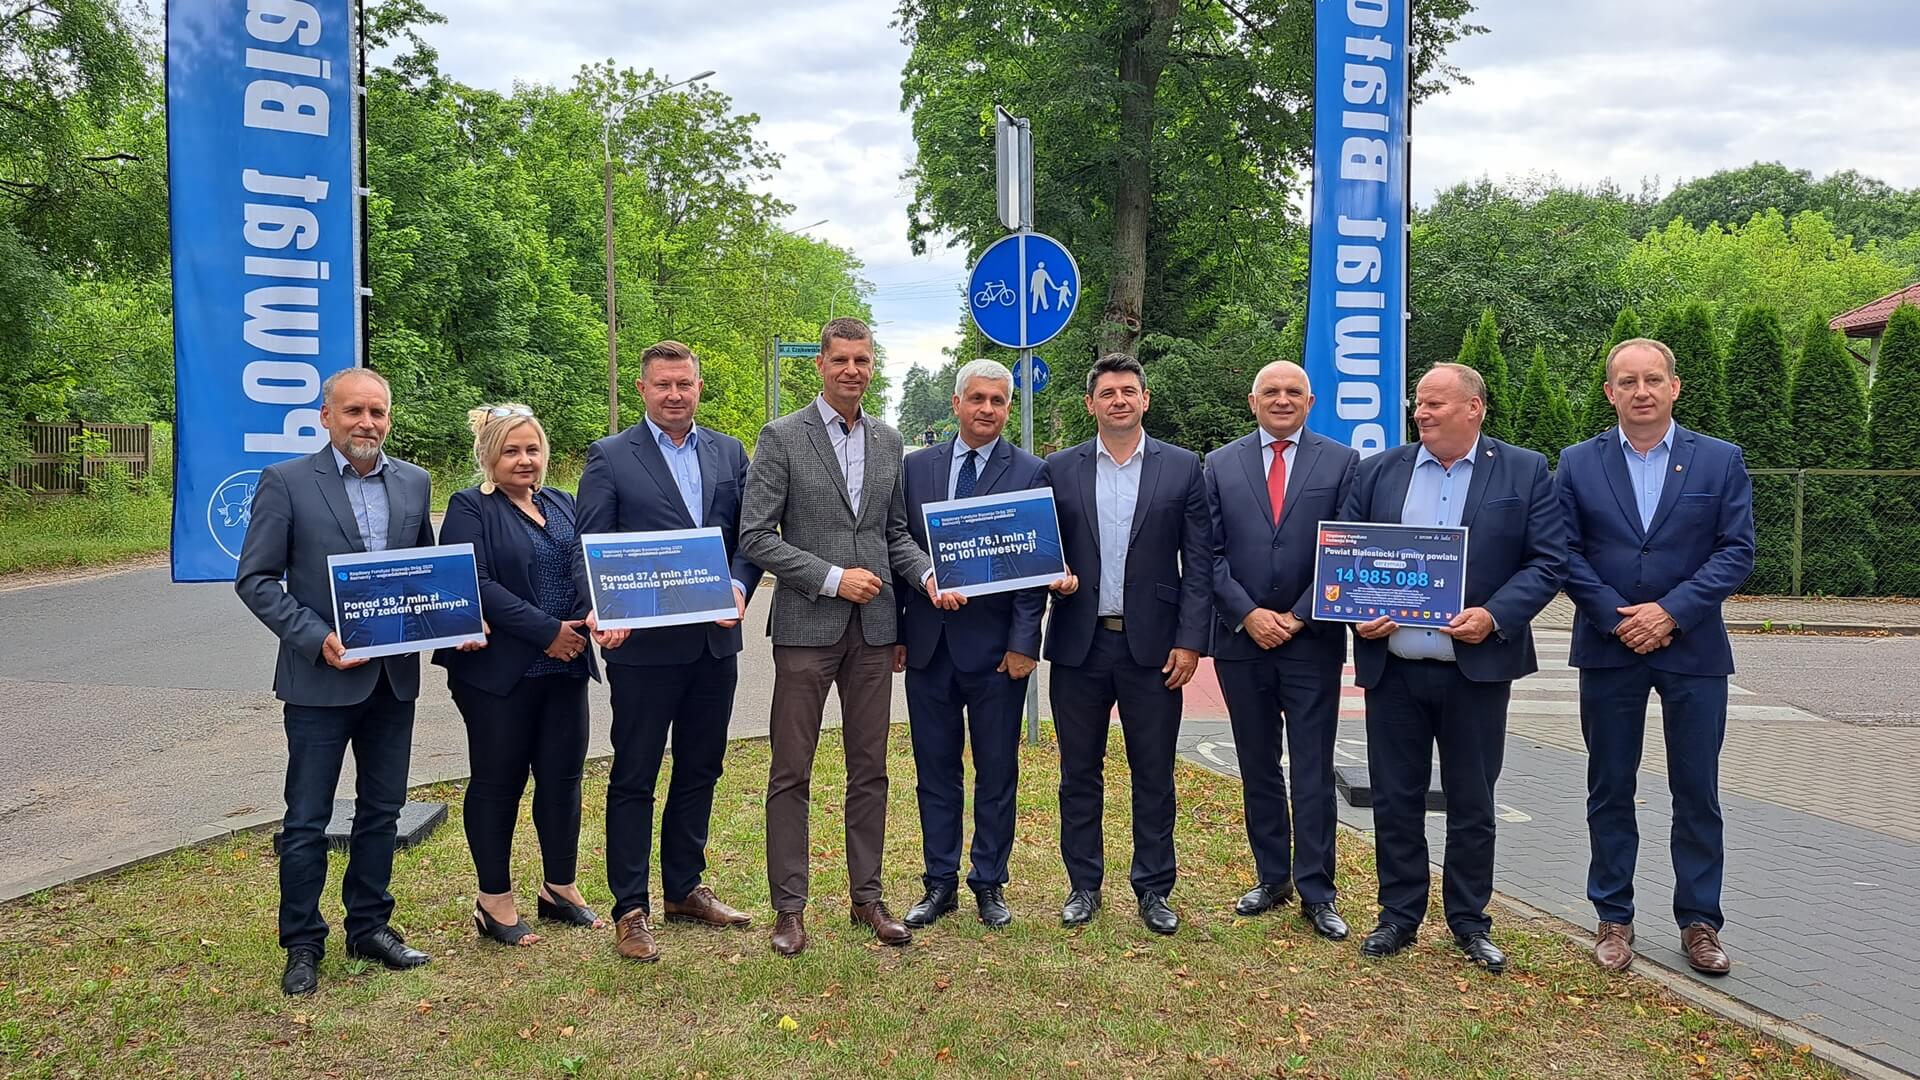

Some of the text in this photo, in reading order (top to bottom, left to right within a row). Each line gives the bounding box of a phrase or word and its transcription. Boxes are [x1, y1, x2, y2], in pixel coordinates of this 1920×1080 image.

[939, 530, 1037, 552] Ponad 76,1 mln zł
[941, 540, 1037, 562] na 101 inwestycji
[1324, 548, 1351, 556] Powiat
[1352, 549, 1394, 559] Białostocki
[1401, 552, 1425, 561] gminy
[1426, 552, 1458, 561] powiatu
[600, 572, 634, 583] Ponad
[636, 571, 658, 581] 37,4
[661, 569, 681, 579] mln
[683, 568, 692, 577] zł
[602, 575, 720, 591] 34 zadania powiatowe
[1336, 568, 1444, 588] 14 985 088 zł
[344, 592, 440, 611] Ponad 38,7 mln zł
[345, 598, 469, 620] na 67 zadań gminnych
